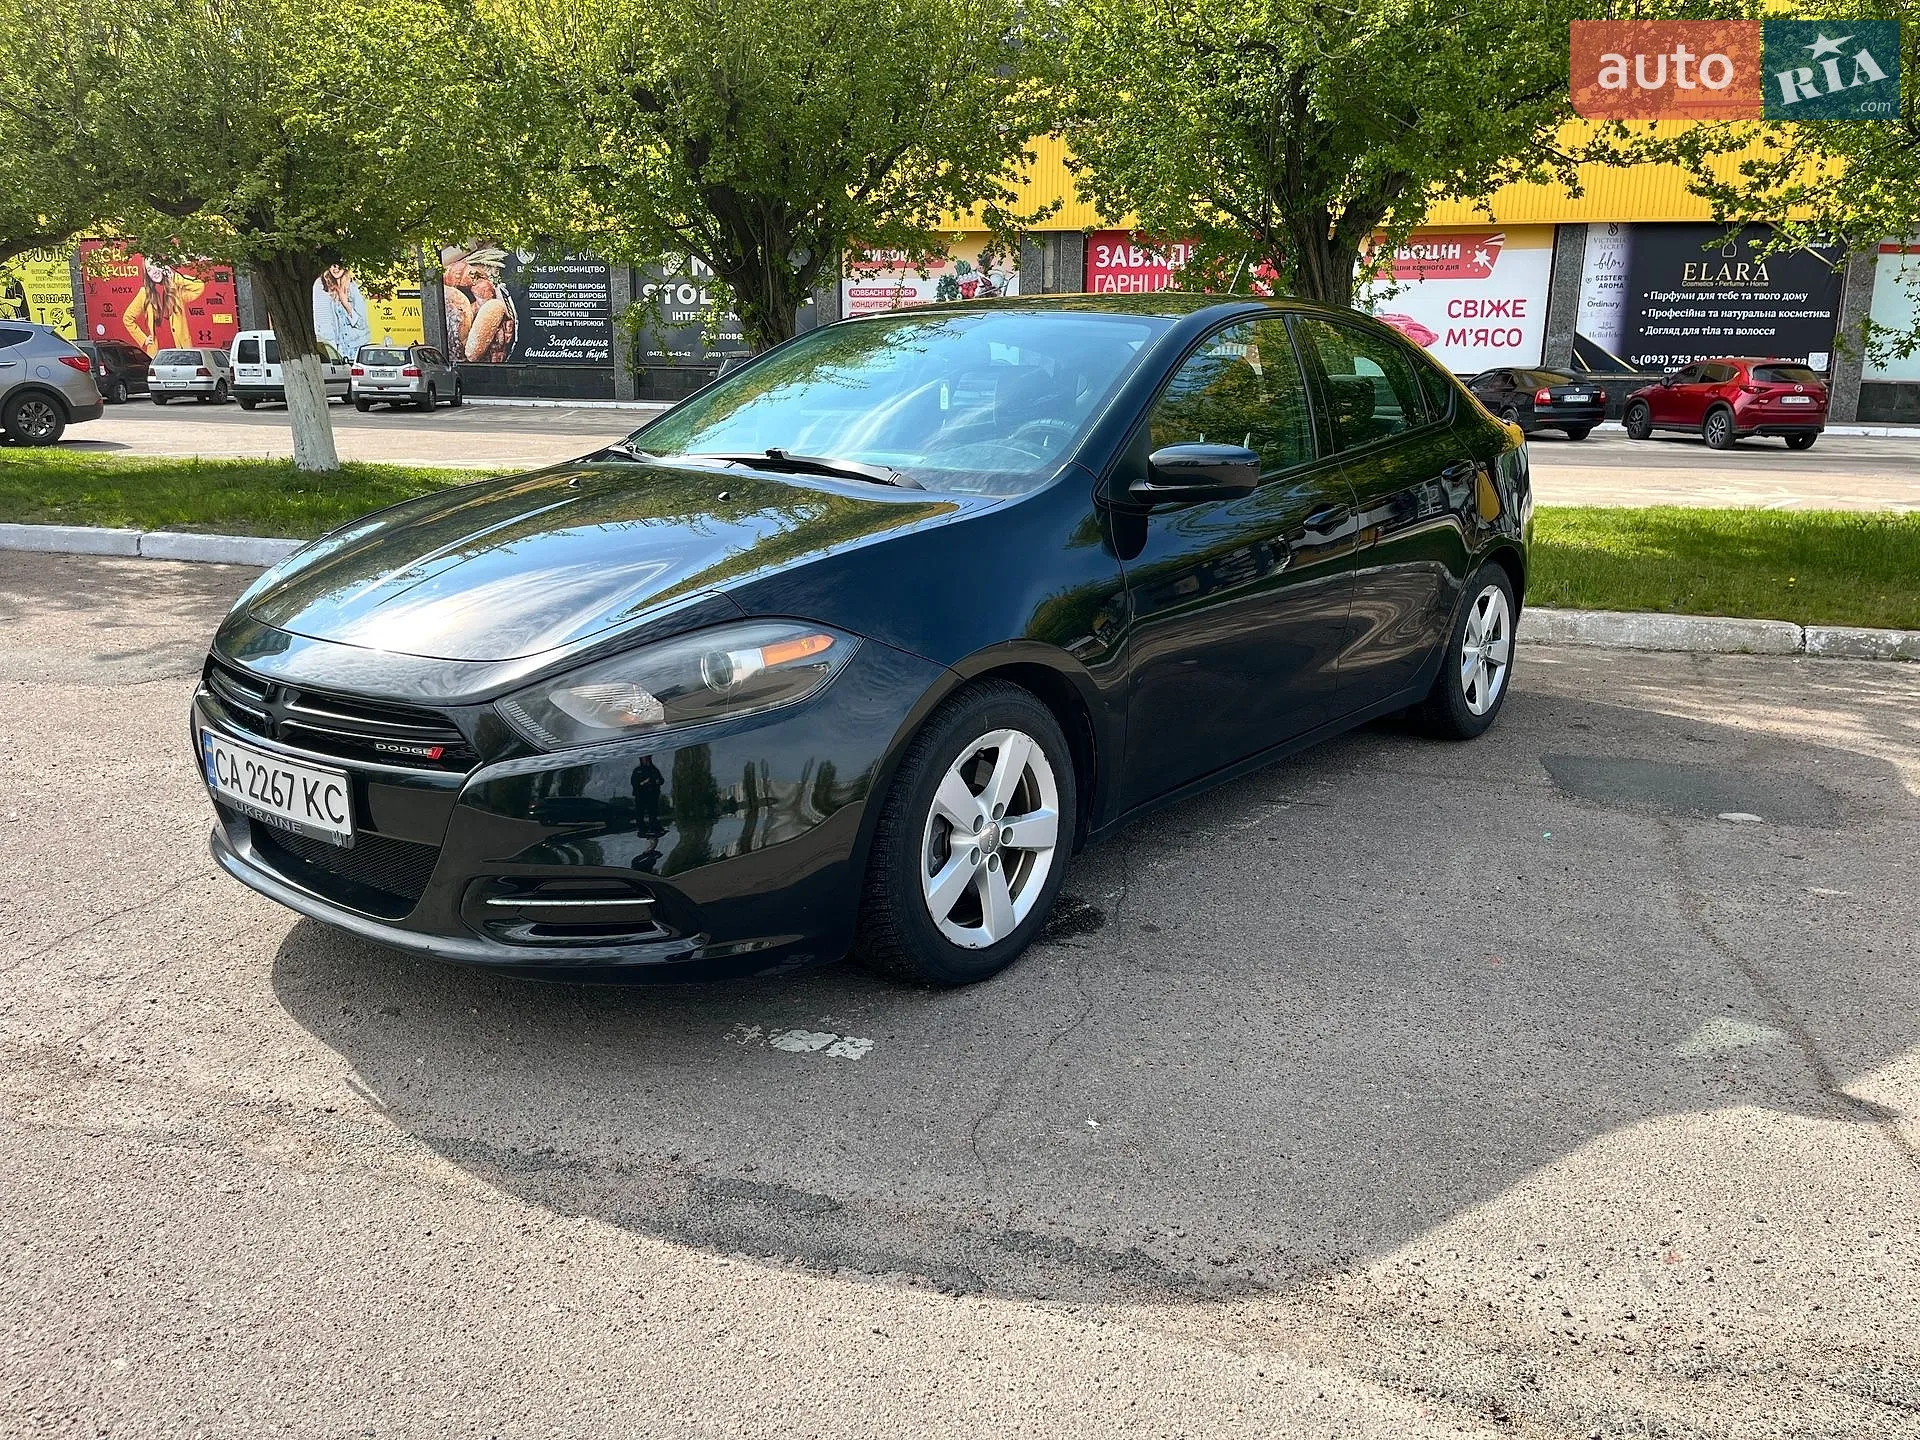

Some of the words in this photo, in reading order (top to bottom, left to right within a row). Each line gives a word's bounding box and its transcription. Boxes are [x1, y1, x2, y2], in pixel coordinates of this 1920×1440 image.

[517, 265, 547, 273] ВСНЕ
[548, 265, 606, 275] ВИРОБНИЦТВО
[1682, 262, 1770, 281] ELARA
[1095, 274, 1149, 293] ГАРНІ
[1650, 290, 1695, 303] Парфуми
[1697, 292, 1715, 301] для
[1717, 290, 1740, 300] тебе
[1781, 293, 1809, 303] дому
[189, 307, 205, 316] VANS
[539, 301, 569, 309] СОЛОДКІ
[1447, 299, 1527, 319] СВІЖЕ
[1648, 307, 1706, 320] Професійна
[1708, 310, 1719, 318] та
[1720, 310, 1777, 320] натуральна
[1778, 310, 1831, 319] косметика
[1645, 326, 1680, 336] Догляд
[1681, 328, 1700, 336] для
[1702, 326, 1721, 335] тіла
[1735, 327, 1776, 336] волосся
[548, 334, 608, 349] Задоволення
[524, 347, 583, 358] випікається
[586, 348, 608, 362] тут
[1640, 354, 1669, 366] (093)
[1671, 354, 1691, 364] 753
[375, 743, 432, 755] DODGE
[215, 748, 243, 794] CA
[245, 760, 295, 811] 2267
[302, 777, 345, 824] KC
[235, 801, 304, 834] UKRAINE
